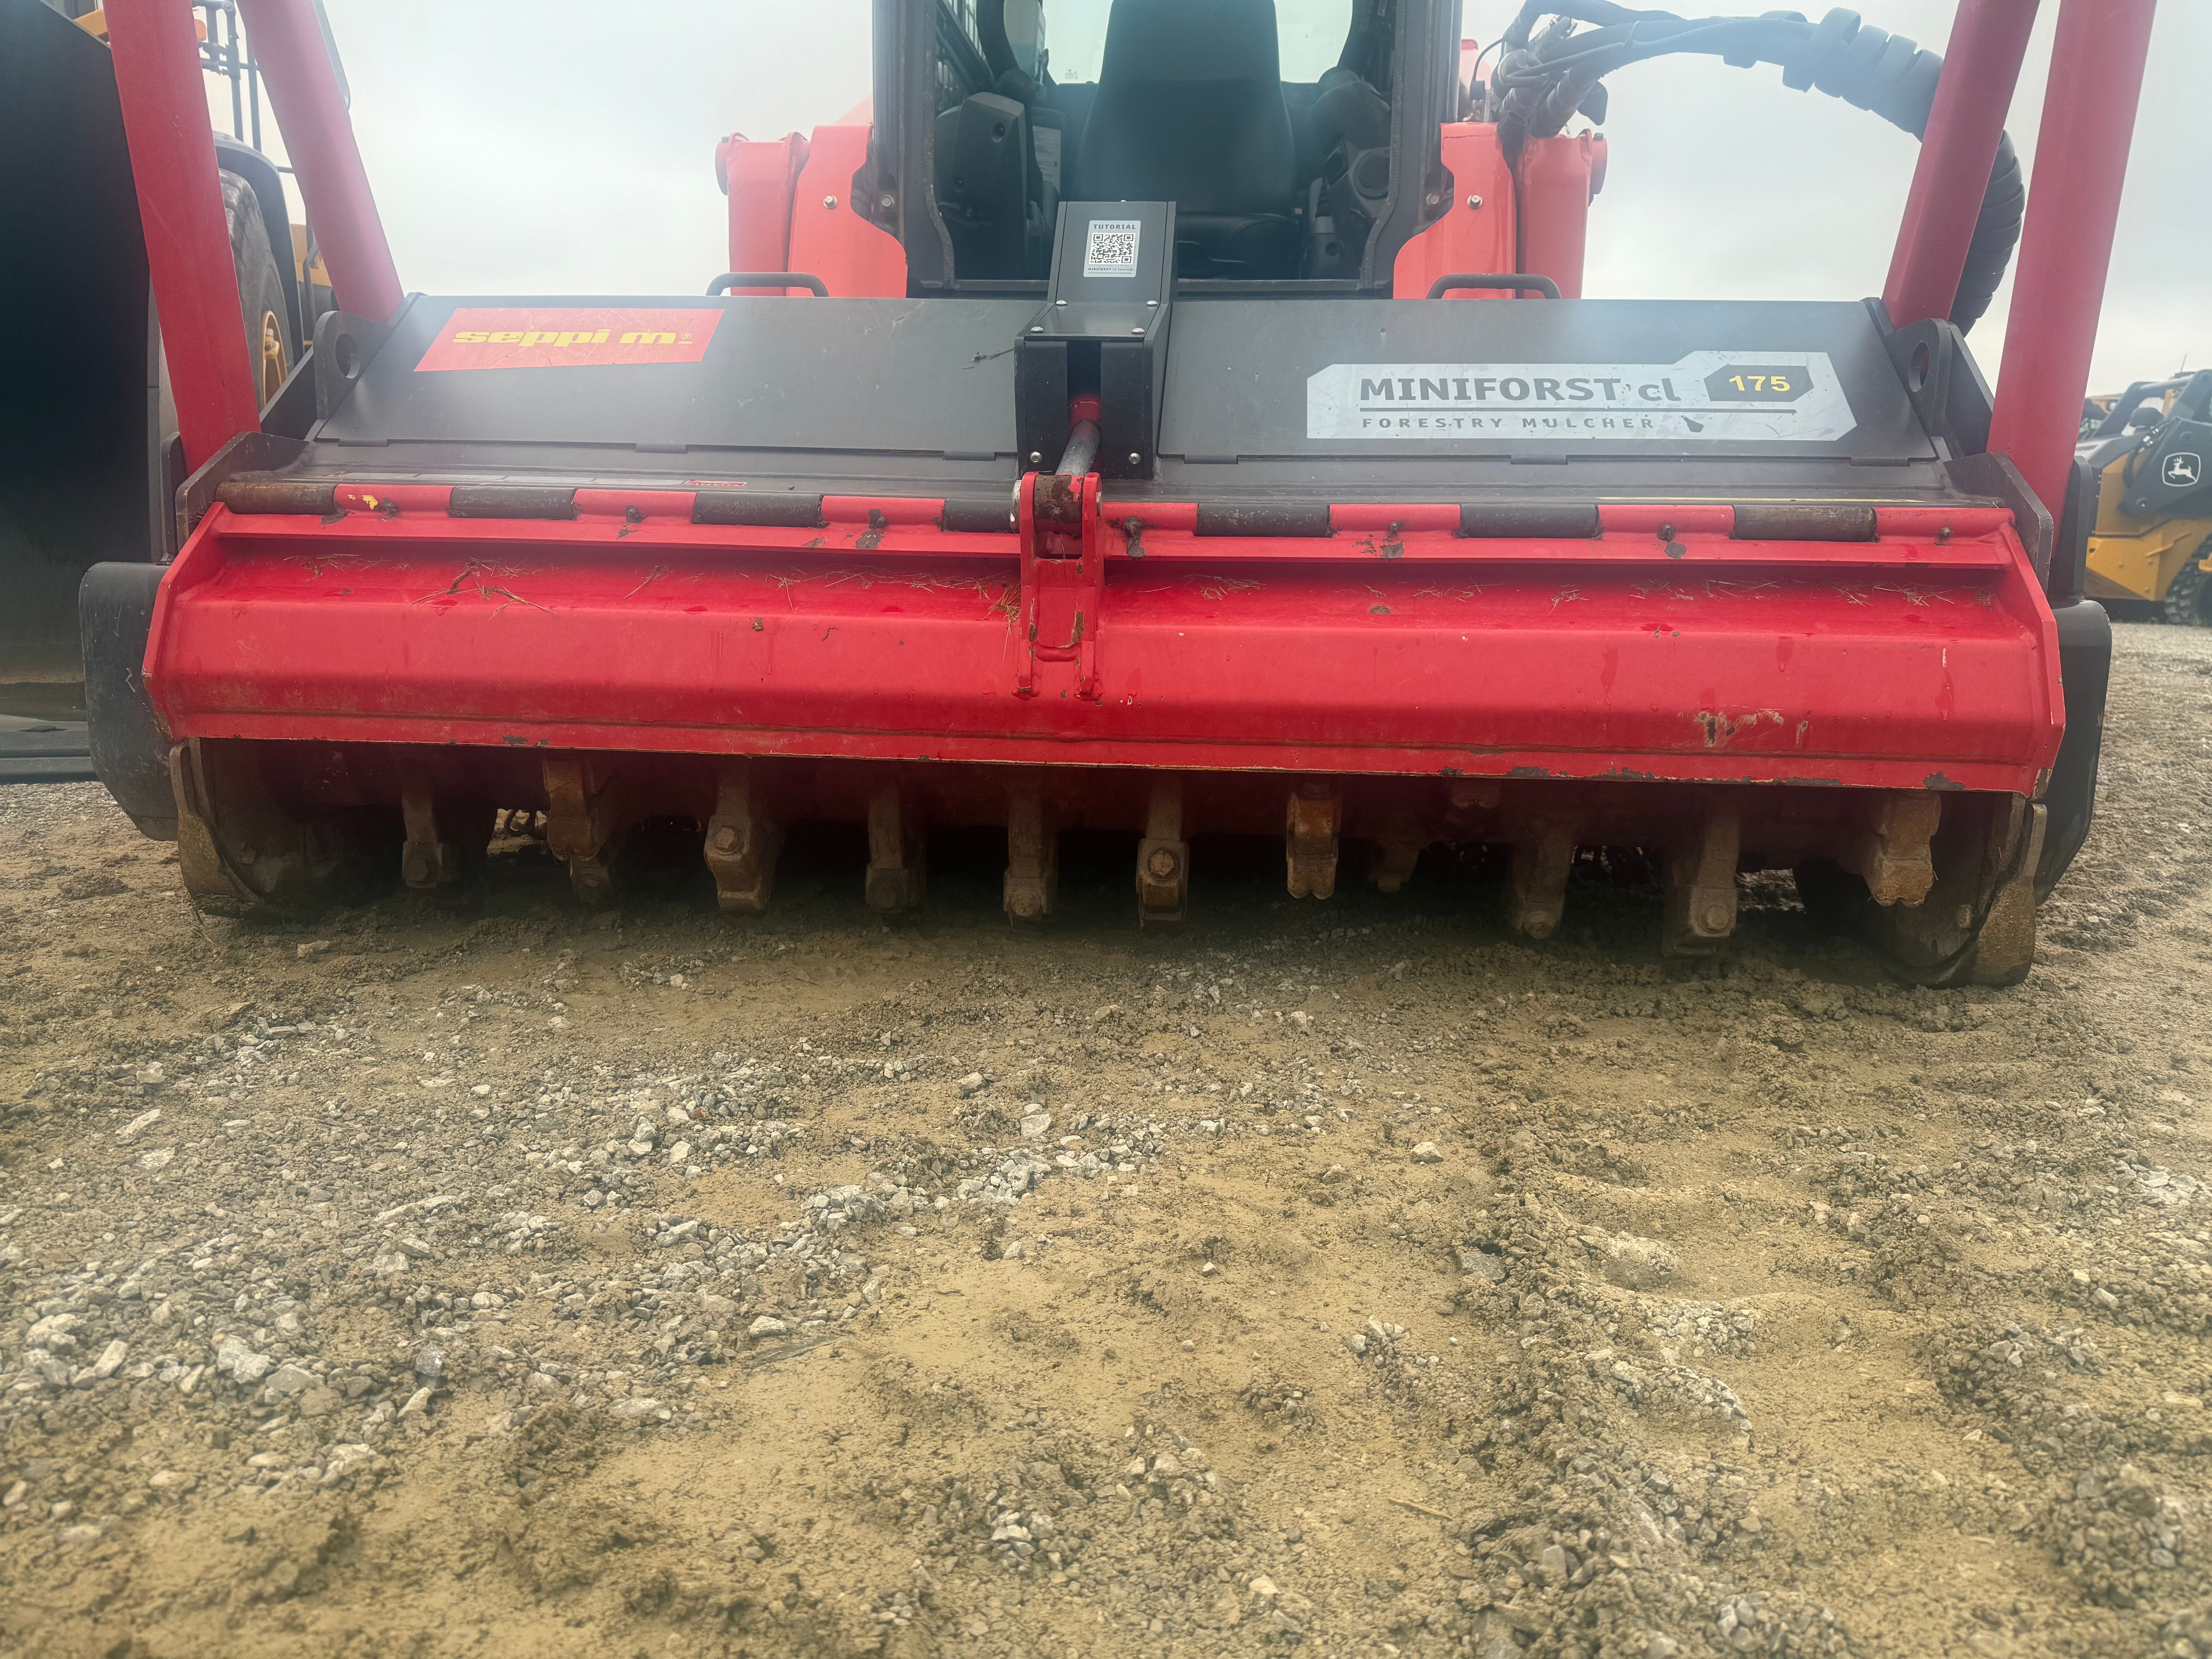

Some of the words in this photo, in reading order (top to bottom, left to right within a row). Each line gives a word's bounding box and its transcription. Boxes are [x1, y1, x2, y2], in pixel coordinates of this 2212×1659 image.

[452, 329, 612, 347] seppi
[1360, 378, 1621, 401] MINIFORST
[1638, 378, 1681, 401] cl
[1729, 375, 1790, 392] 175
[1362, 418, 1502, 428] FORESTRY
[1522, 418, 1654, 428] MULCHER
